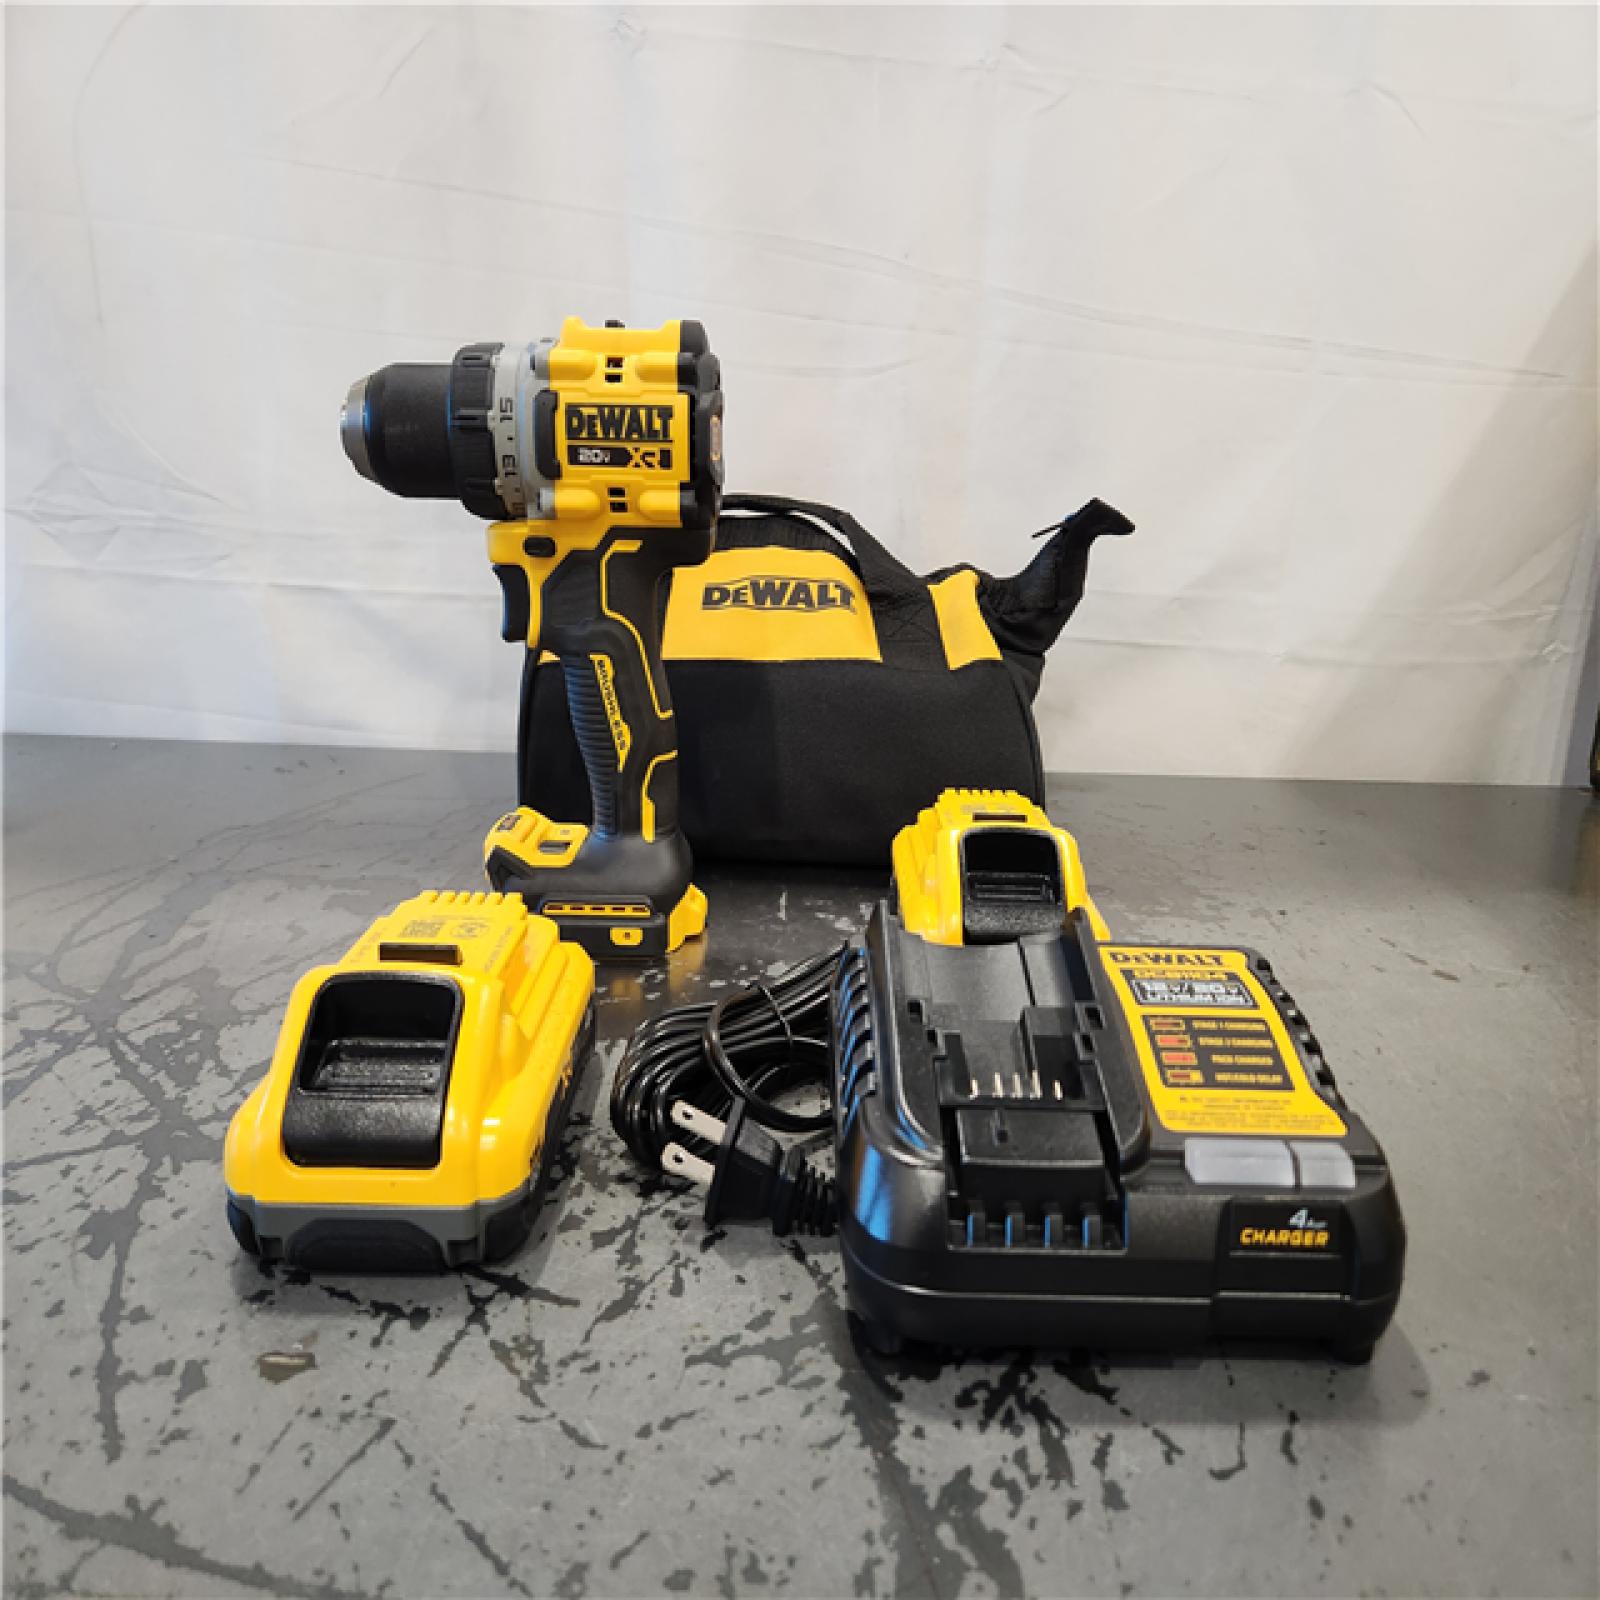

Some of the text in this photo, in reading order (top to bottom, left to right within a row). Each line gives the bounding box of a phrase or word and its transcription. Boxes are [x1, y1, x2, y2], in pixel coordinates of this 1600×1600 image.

[499, 397, 513, 423] 15
[566, 404, 674, 441] DEWALT
[501, 454, 517, 478] 13
[702, 577, 855, 611] DEWALT
[1289, 1207, 1309, 1229] 4
[1240, 1226, 1329, 1248] CHARGER
